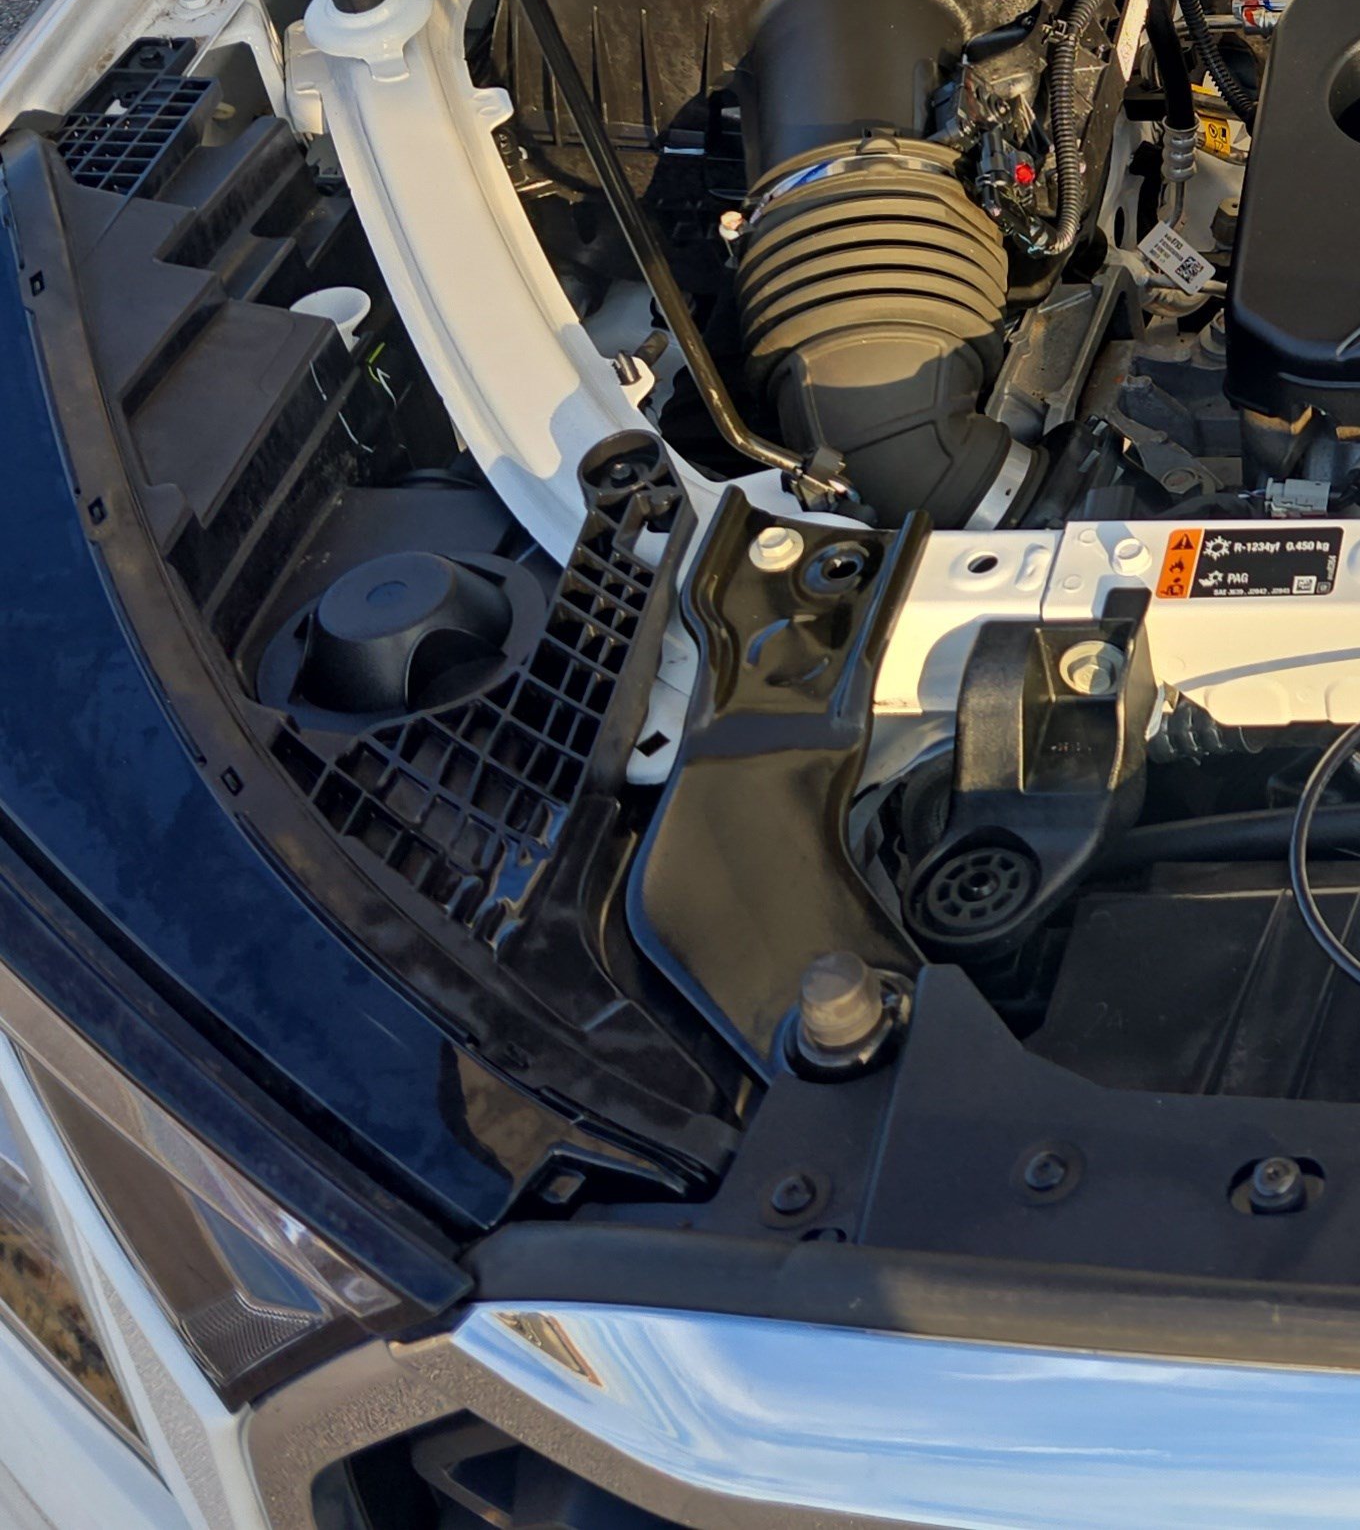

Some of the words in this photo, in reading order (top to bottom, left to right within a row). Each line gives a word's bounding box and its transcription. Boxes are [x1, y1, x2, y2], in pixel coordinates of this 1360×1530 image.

[1233, 542, 1281, 553] R-1234yf
[1285, 540, 1315, 551] 0.450
[1316, 540, 1330, 552] kg
[1227, 572, 1249, 584] PAG
